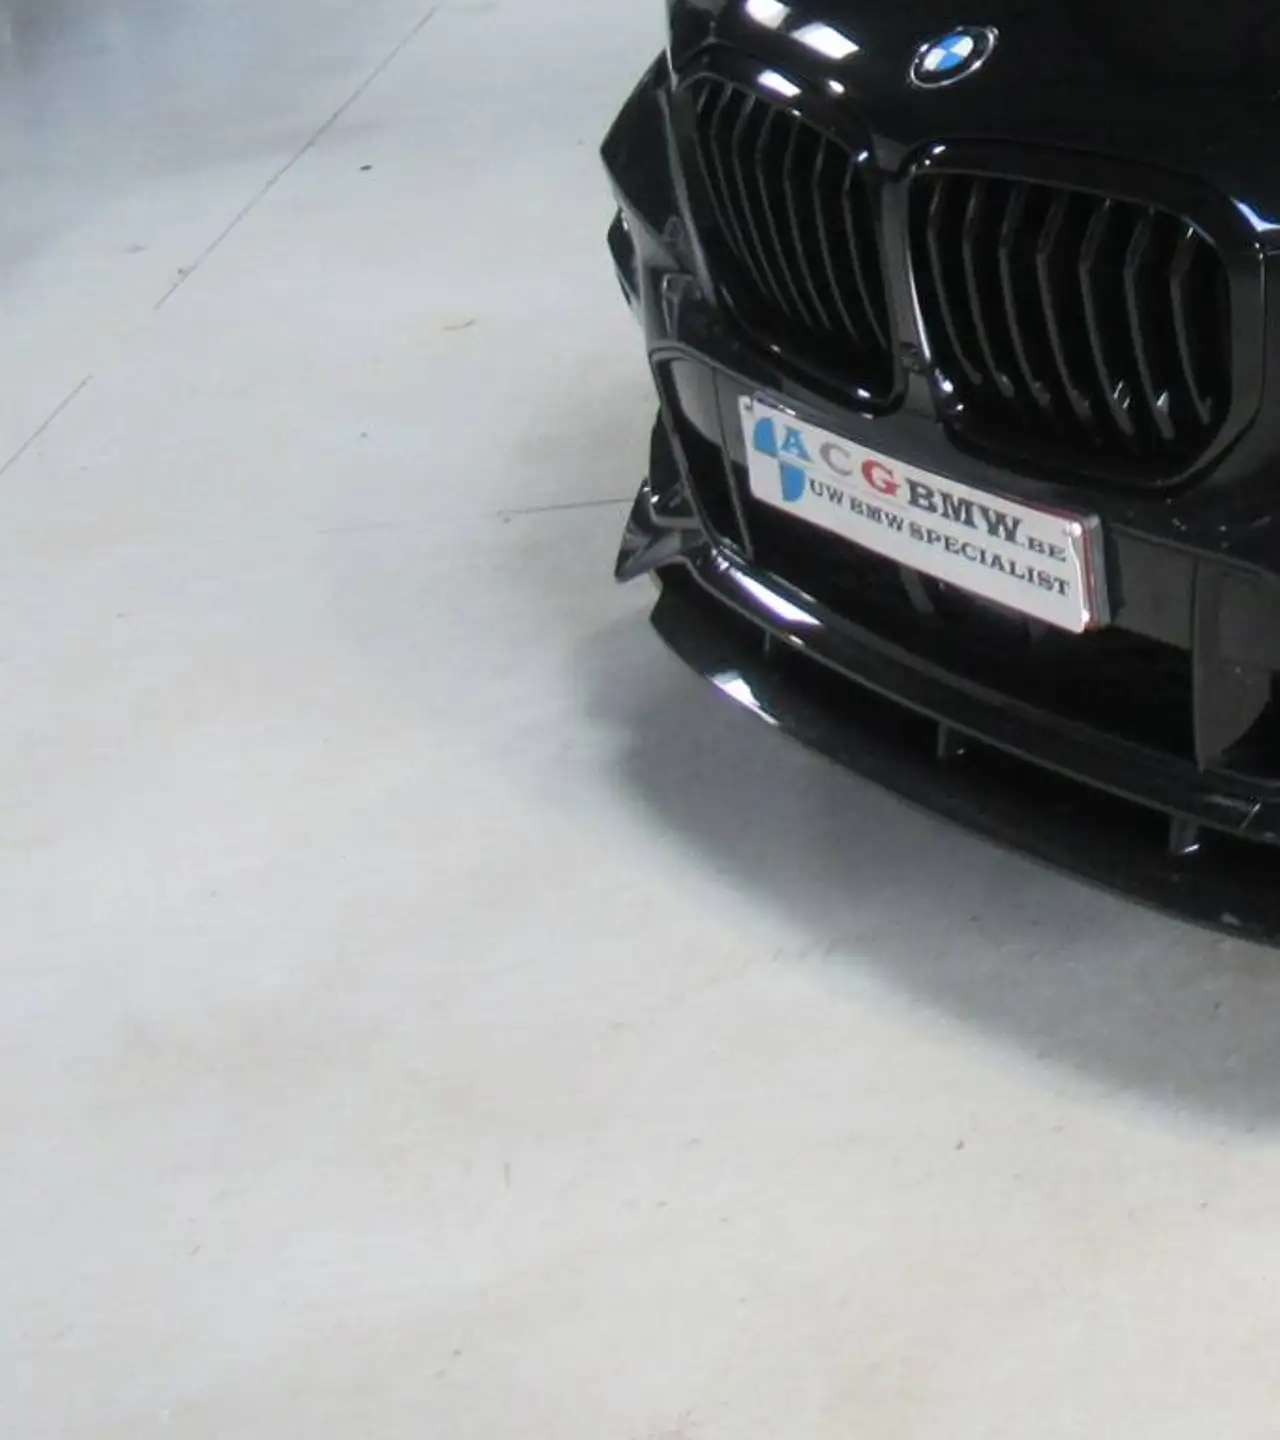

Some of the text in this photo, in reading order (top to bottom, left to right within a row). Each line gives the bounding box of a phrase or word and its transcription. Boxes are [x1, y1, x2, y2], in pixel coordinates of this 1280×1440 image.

[809, 475, 1072, 597] UW BMW SPECIALIST
